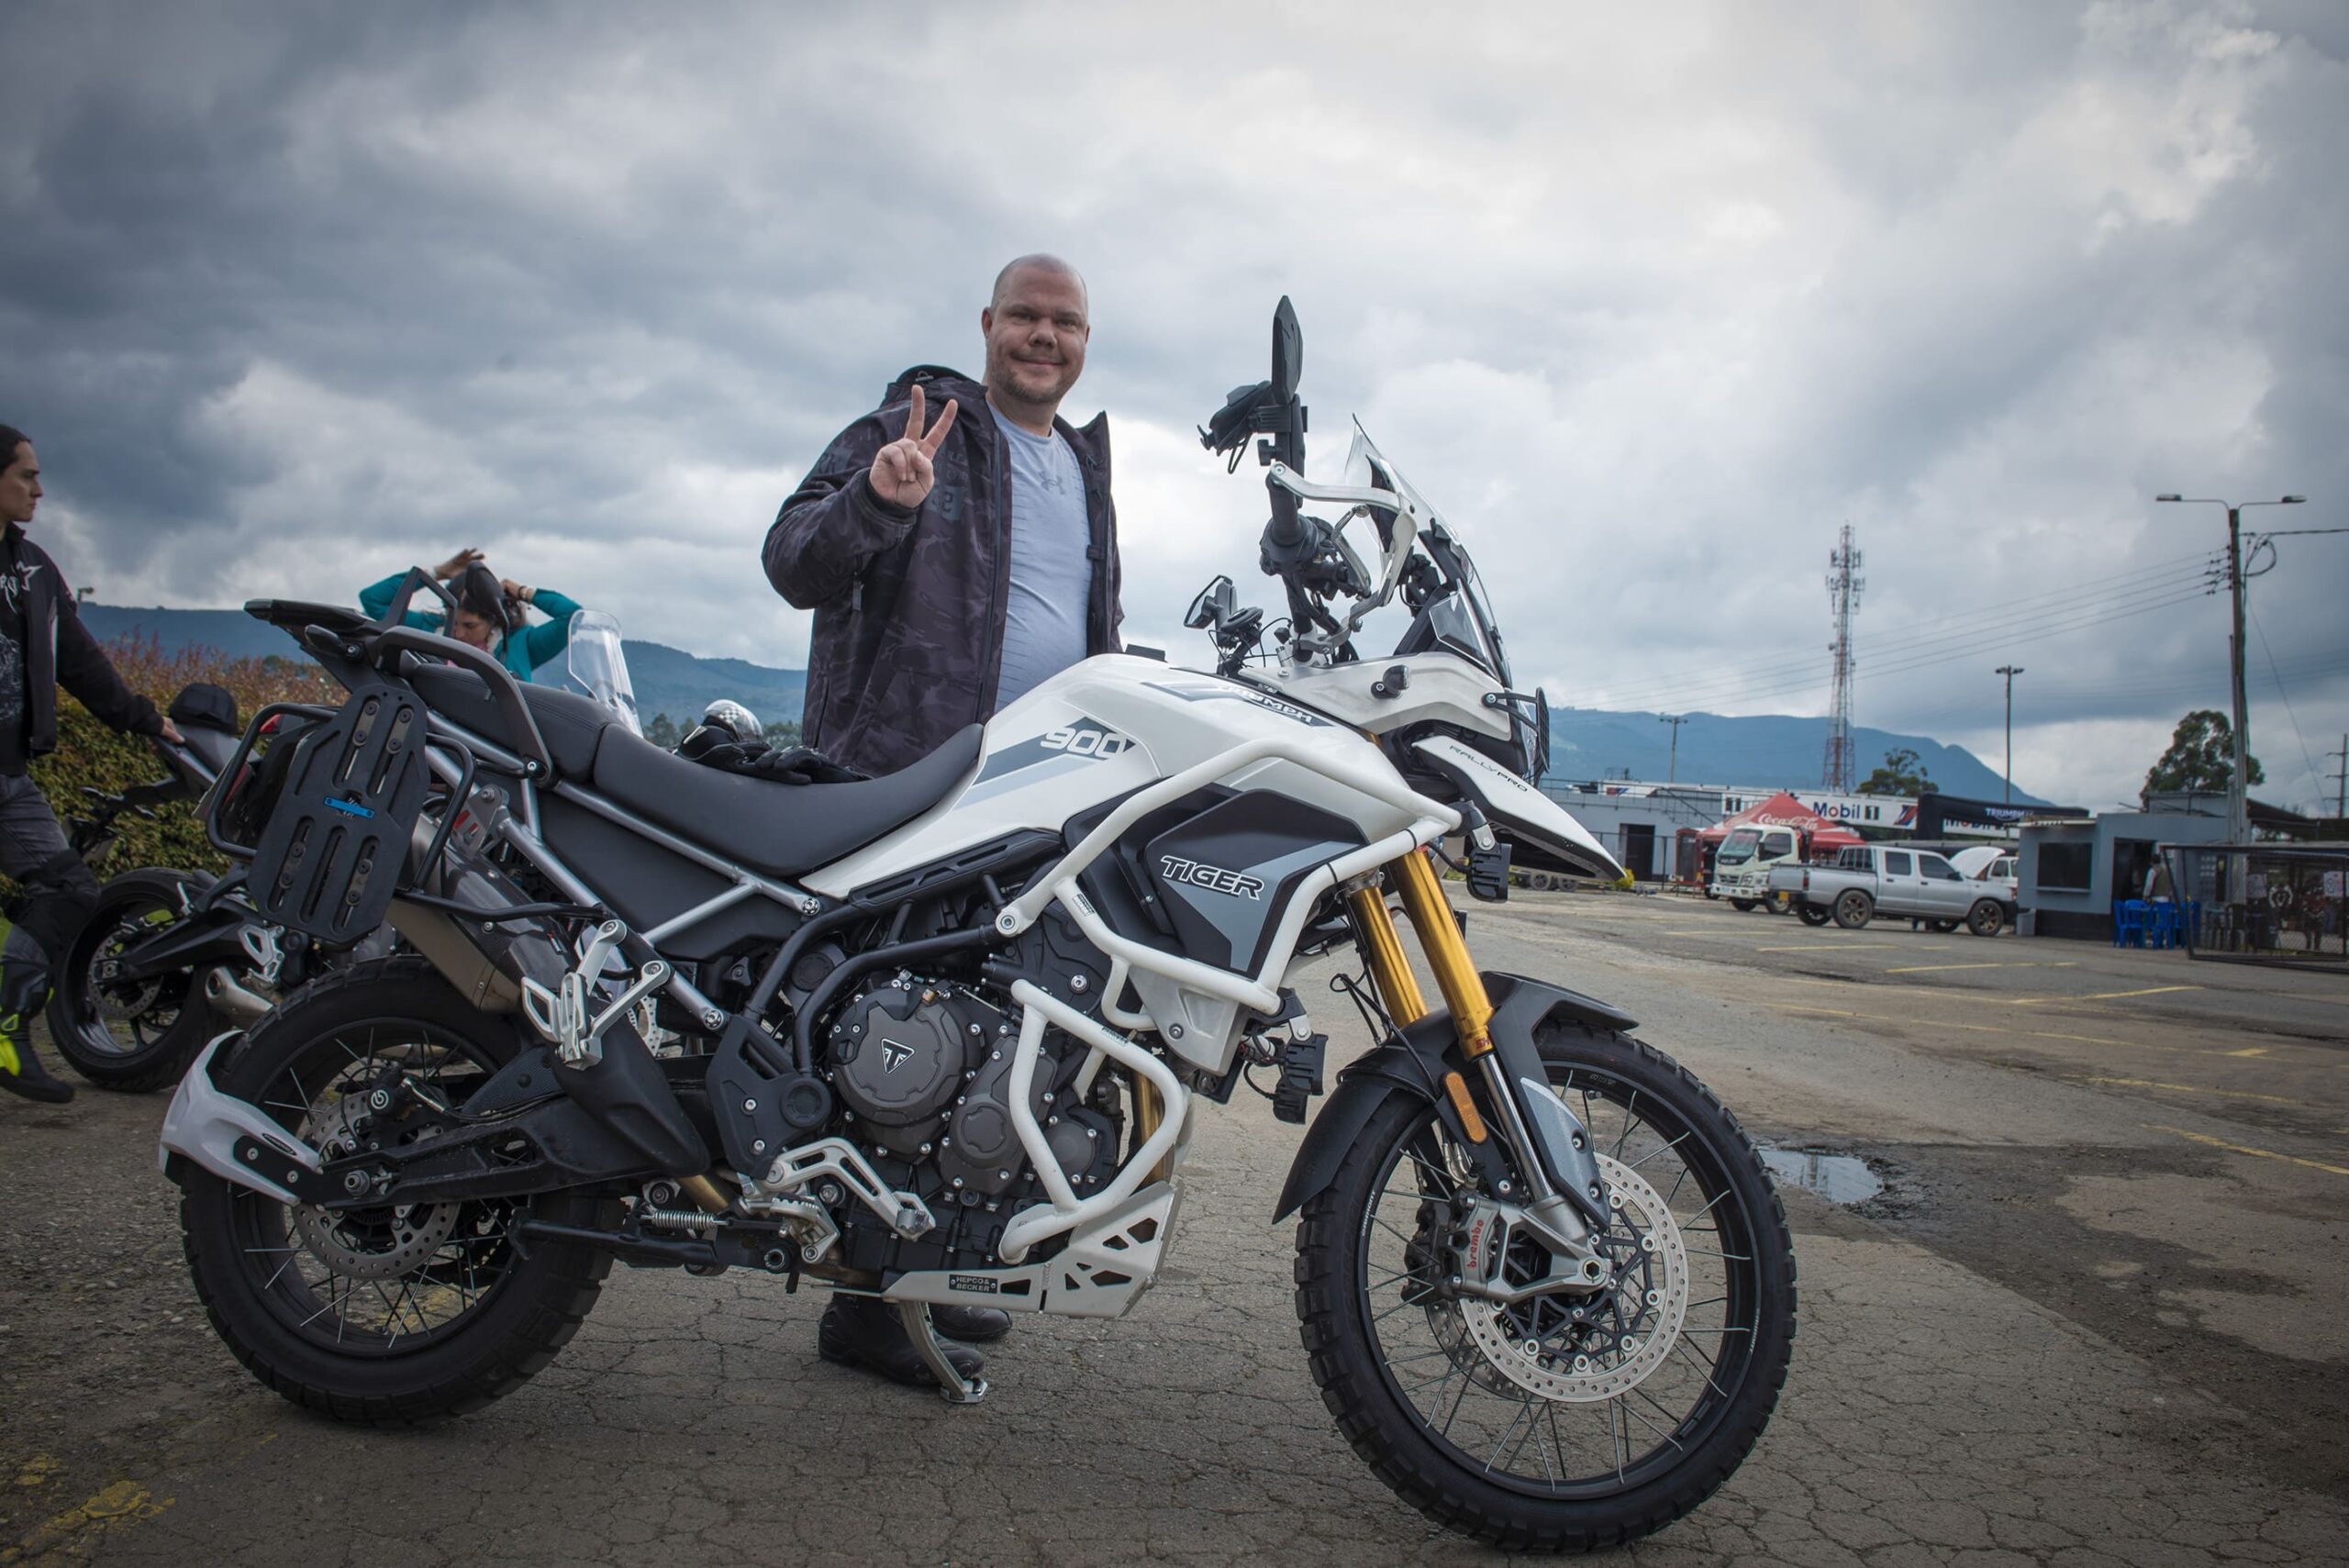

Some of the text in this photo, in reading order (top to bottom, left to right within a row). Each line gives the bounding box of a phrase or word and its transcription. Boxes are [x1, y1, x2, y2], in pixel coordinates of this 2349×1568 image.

[1040, 728, 1127, 758] 900
[1813, 802, 1861, 819] Mobil
[1985, 807, 2024, 817] TRIUMPH
[1161, 855, 1264, 901] TIGER
[1467, 1219, 1484, 1269] brembo
[956, 1284, 990, 1292] BECKER
